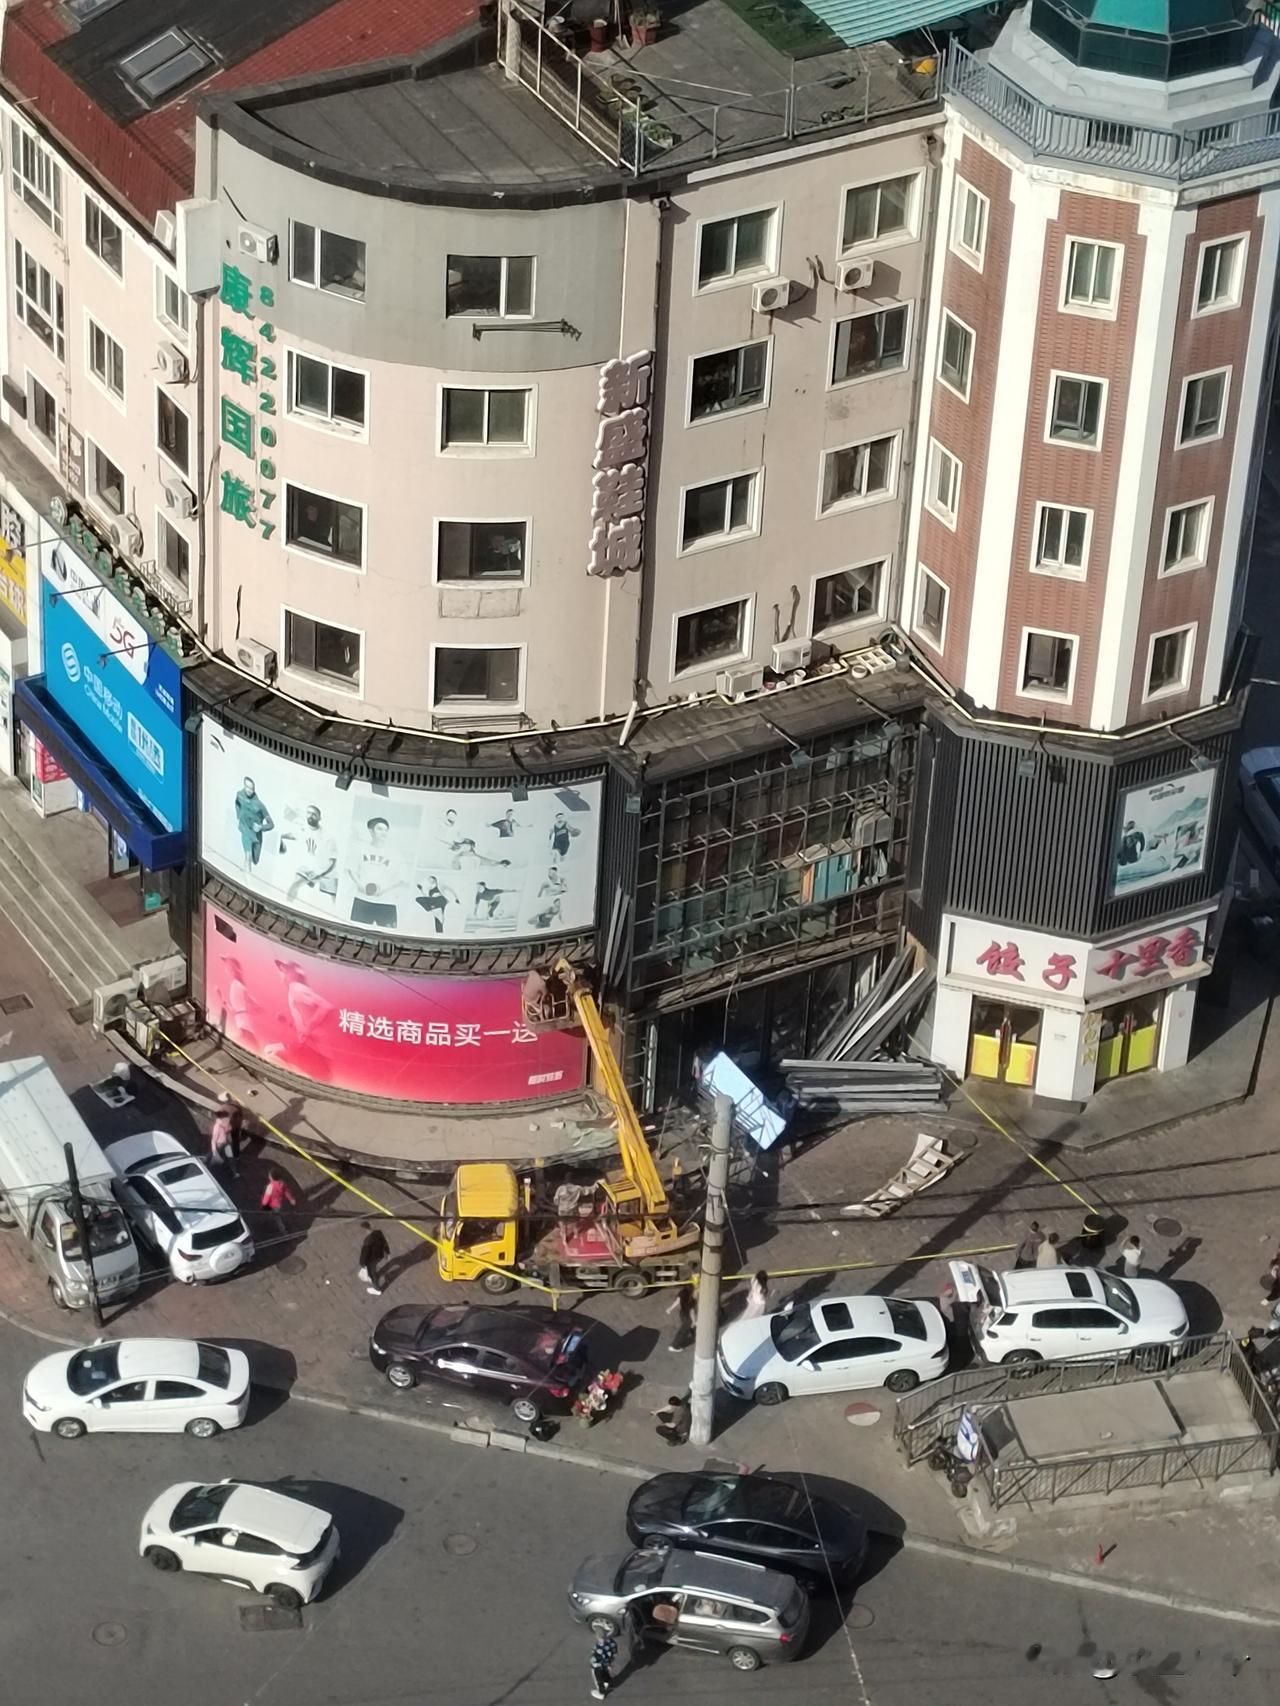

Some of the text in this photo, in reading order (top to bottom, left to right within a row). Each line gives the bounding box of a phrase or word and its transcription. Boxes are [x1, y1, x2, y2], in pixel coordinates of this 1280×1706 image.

[258, 284, 277, 541] 84220077
[83, 665, 123, 720] 中国移动
[975, 939, 1078, 991] 饺子
